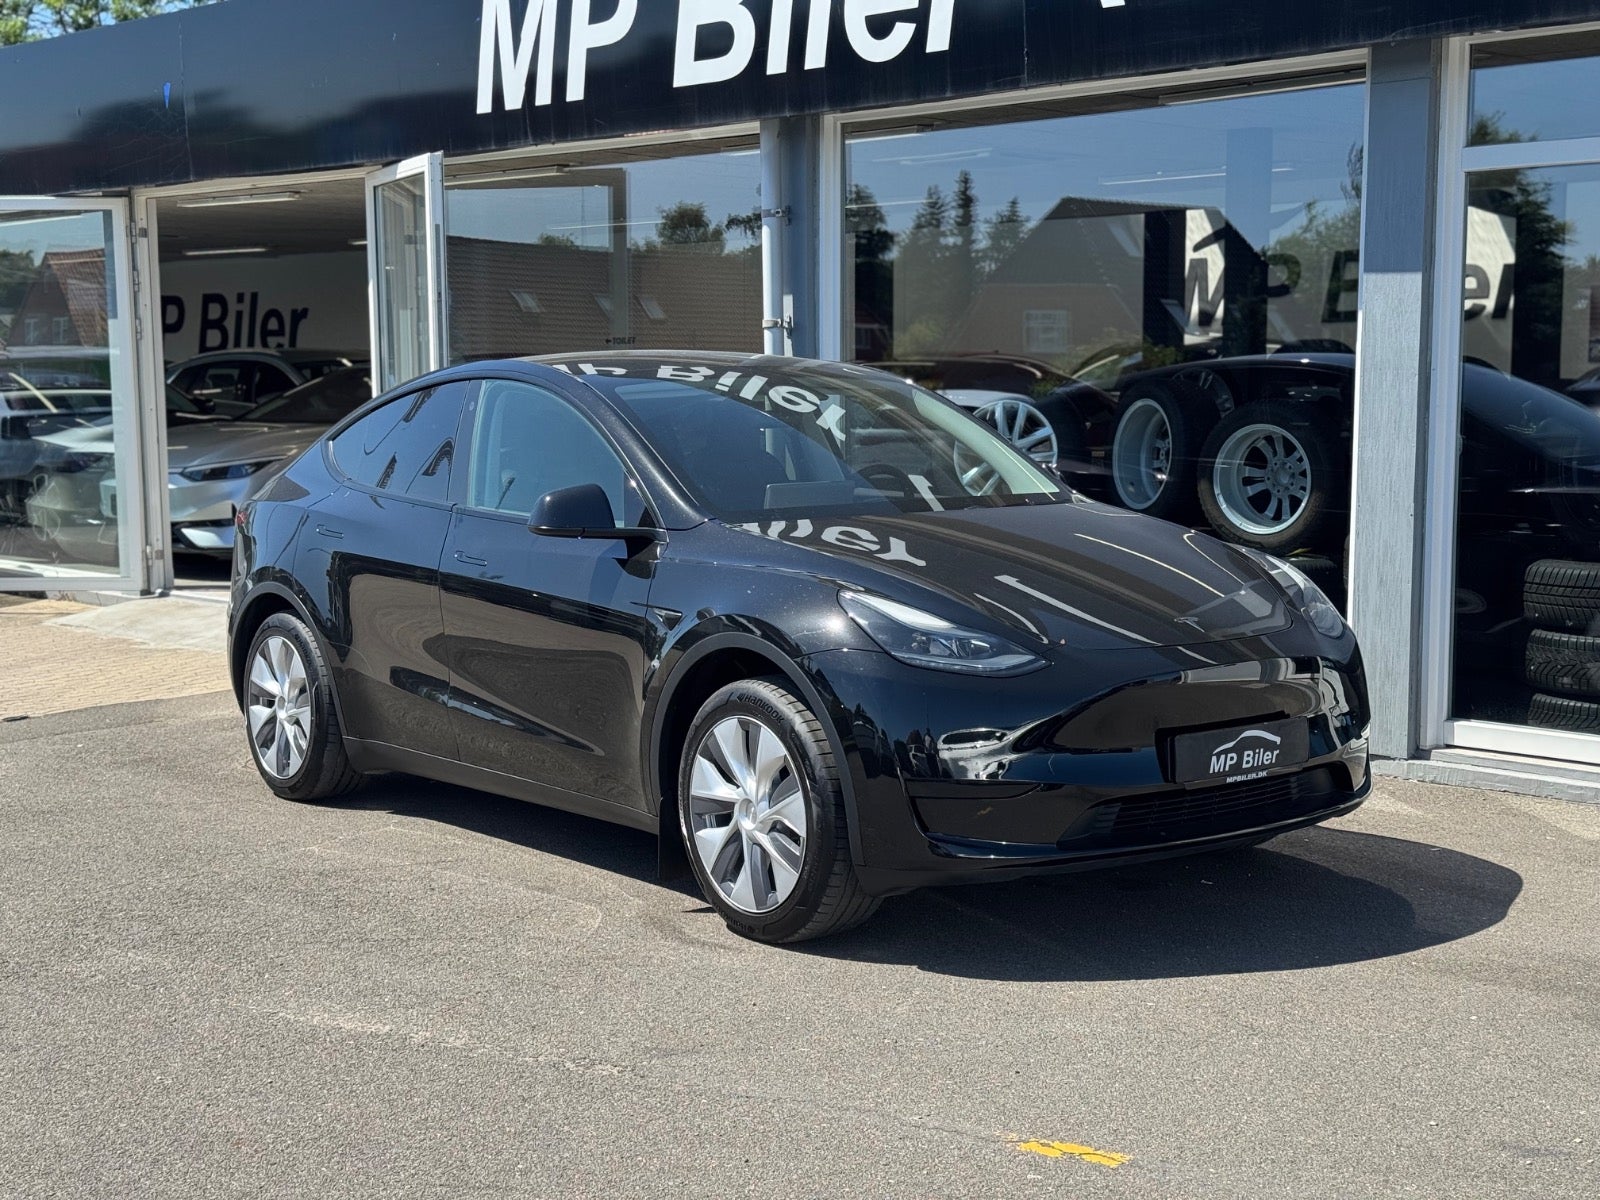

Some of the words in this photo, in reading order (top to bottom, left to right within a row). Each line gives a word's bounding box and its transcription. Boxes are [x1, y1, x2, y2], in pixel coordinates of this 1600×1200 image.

[476, 0, 635, 114] MP
[199, 291, 310, 353] Biler
[612, 336, 637, 345] TOILET
[1209, 752, 1238, 774] MP
[1242, 748, 1280, 769] Biler
[1226, 769, 1269, 783] MPBILER.DK
